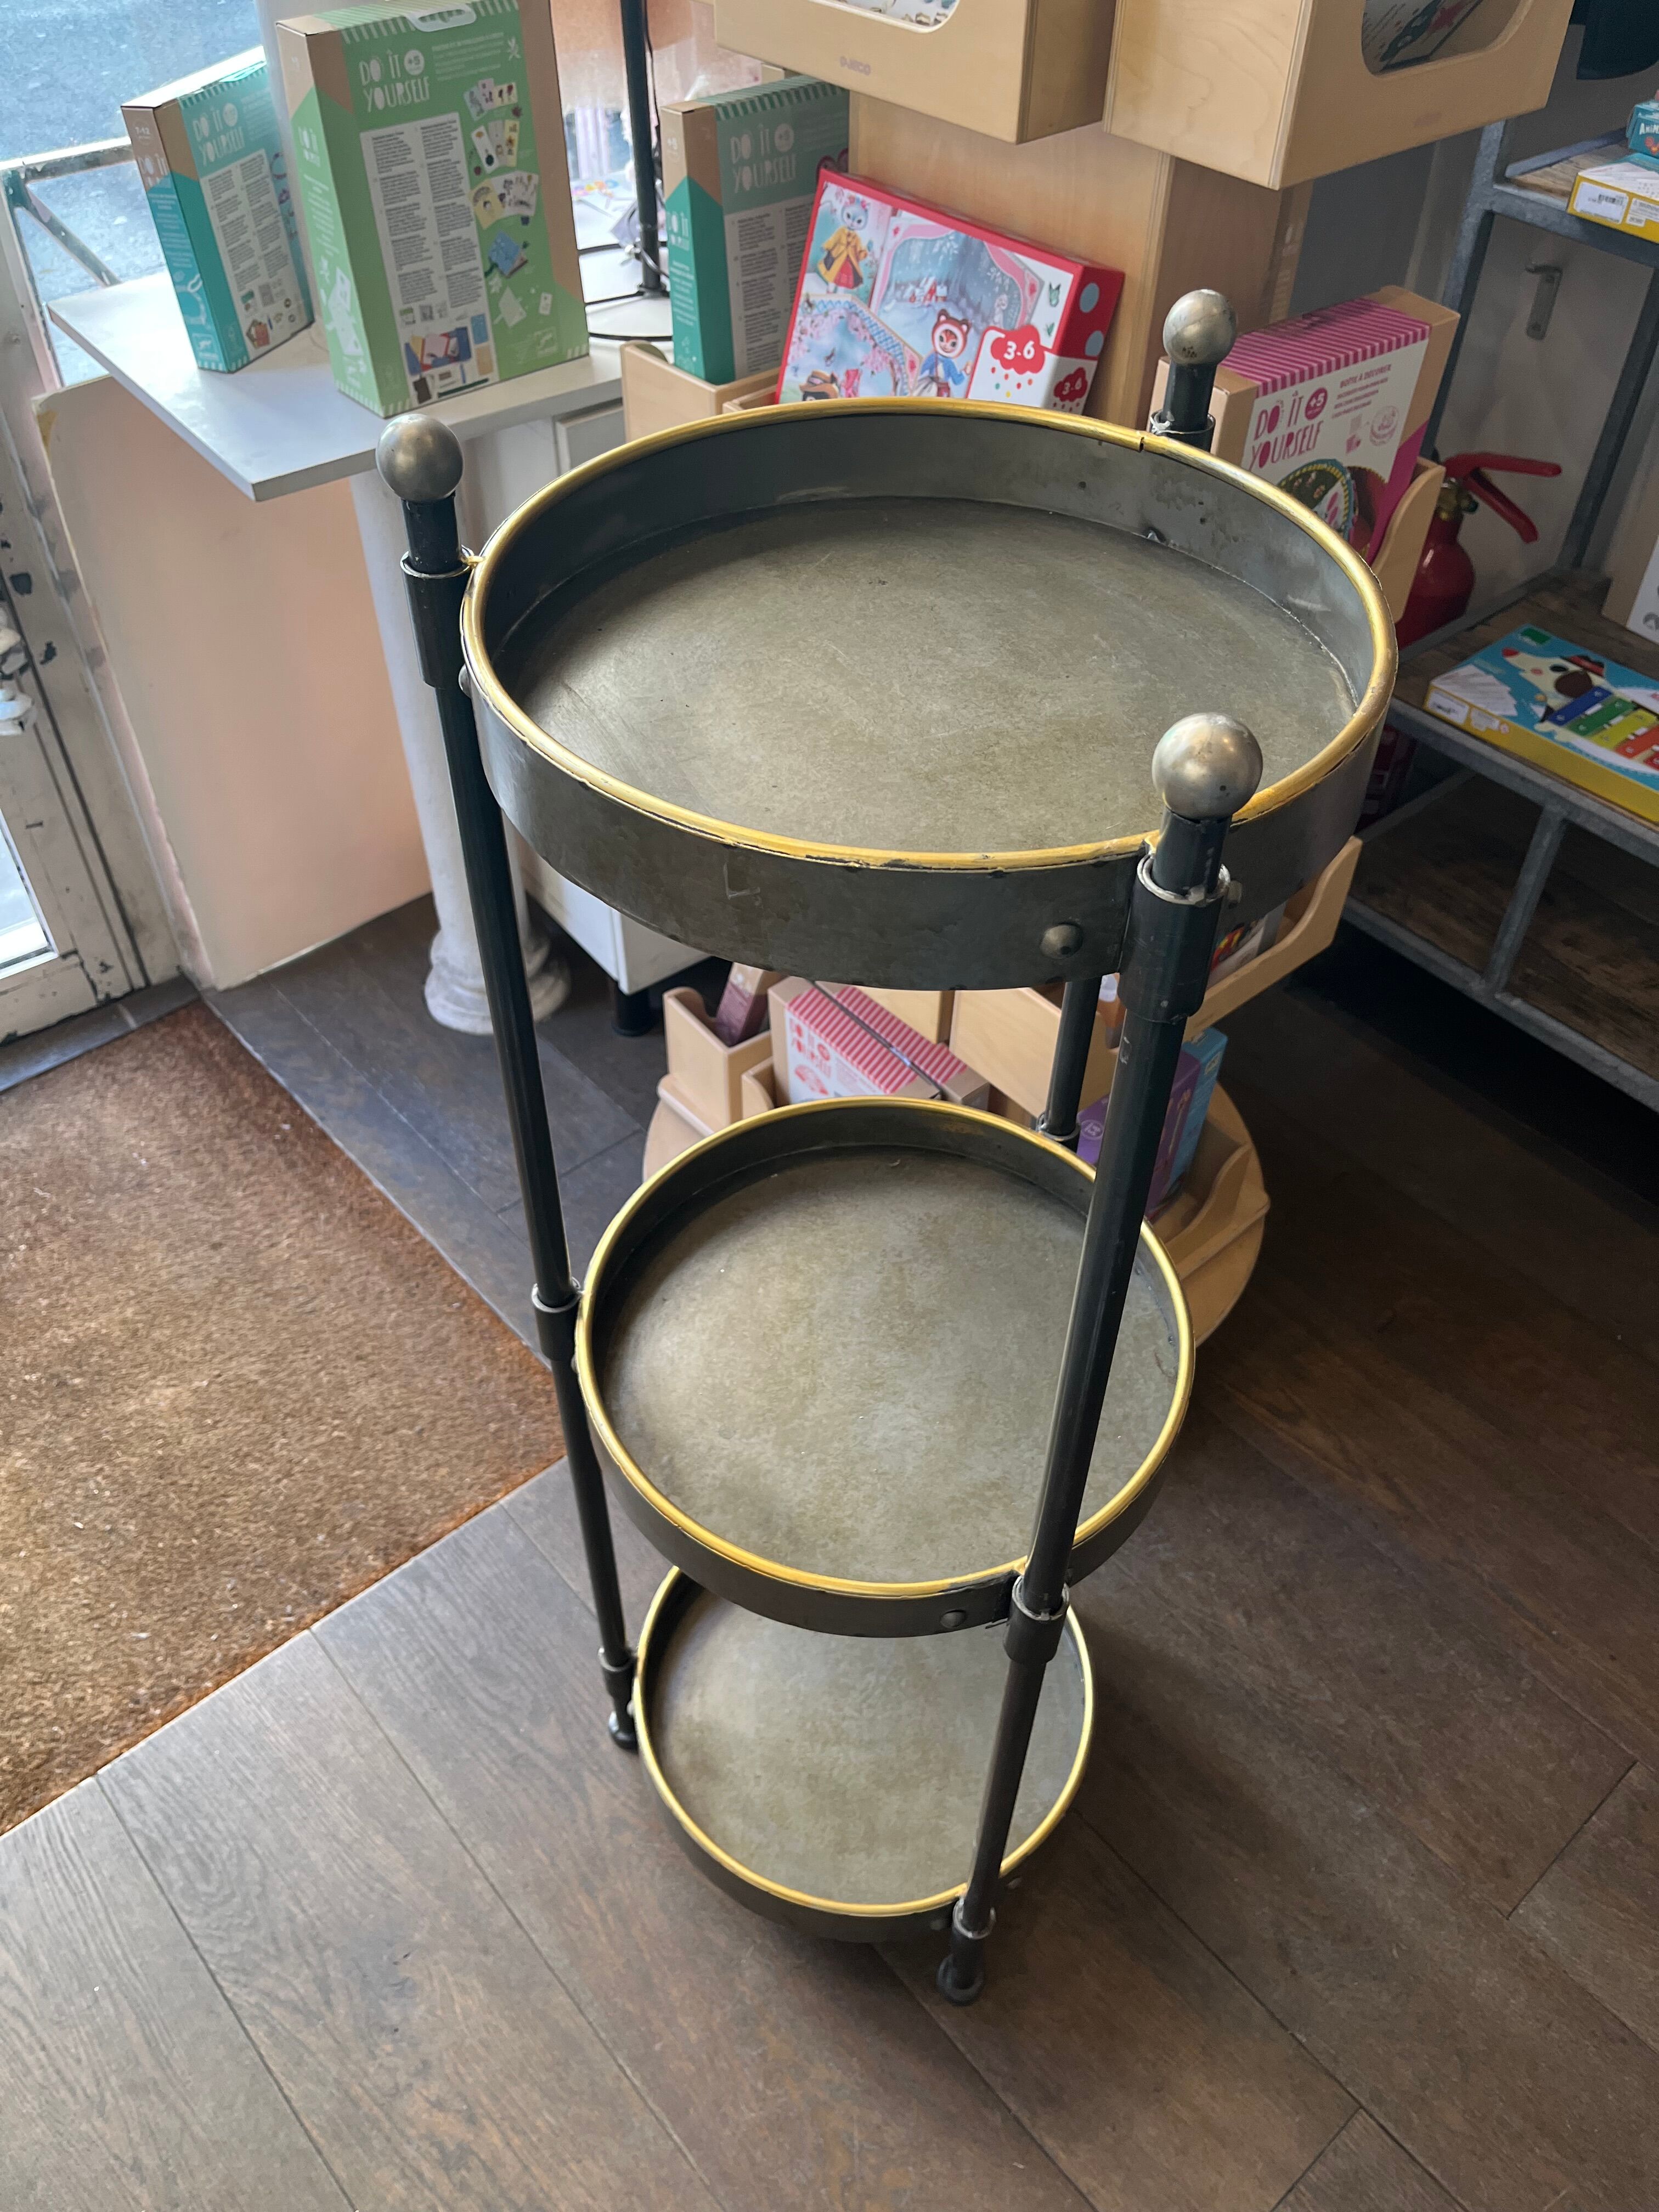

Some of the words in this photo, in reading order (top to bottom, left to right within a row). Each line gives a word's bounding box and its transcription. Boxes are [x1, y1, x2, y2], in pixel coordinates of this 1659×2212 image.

[359, 60, 382, 87] DO
[363, 75, 430, 113] YOURSELF
[193, 116, 210, 142] DO
[198, 127, 246, 167] YOURSELF
[730, 134, 752, 164] DO
[733, 153, 796, 194] YOURSELF
[1003, 334, 1036, 360] 3-6
[1062, 377, 1084, 396] 3-6
[1254, 403, 1281, 441] DO
[1248, 419, 1324, 472] YOURSELF
